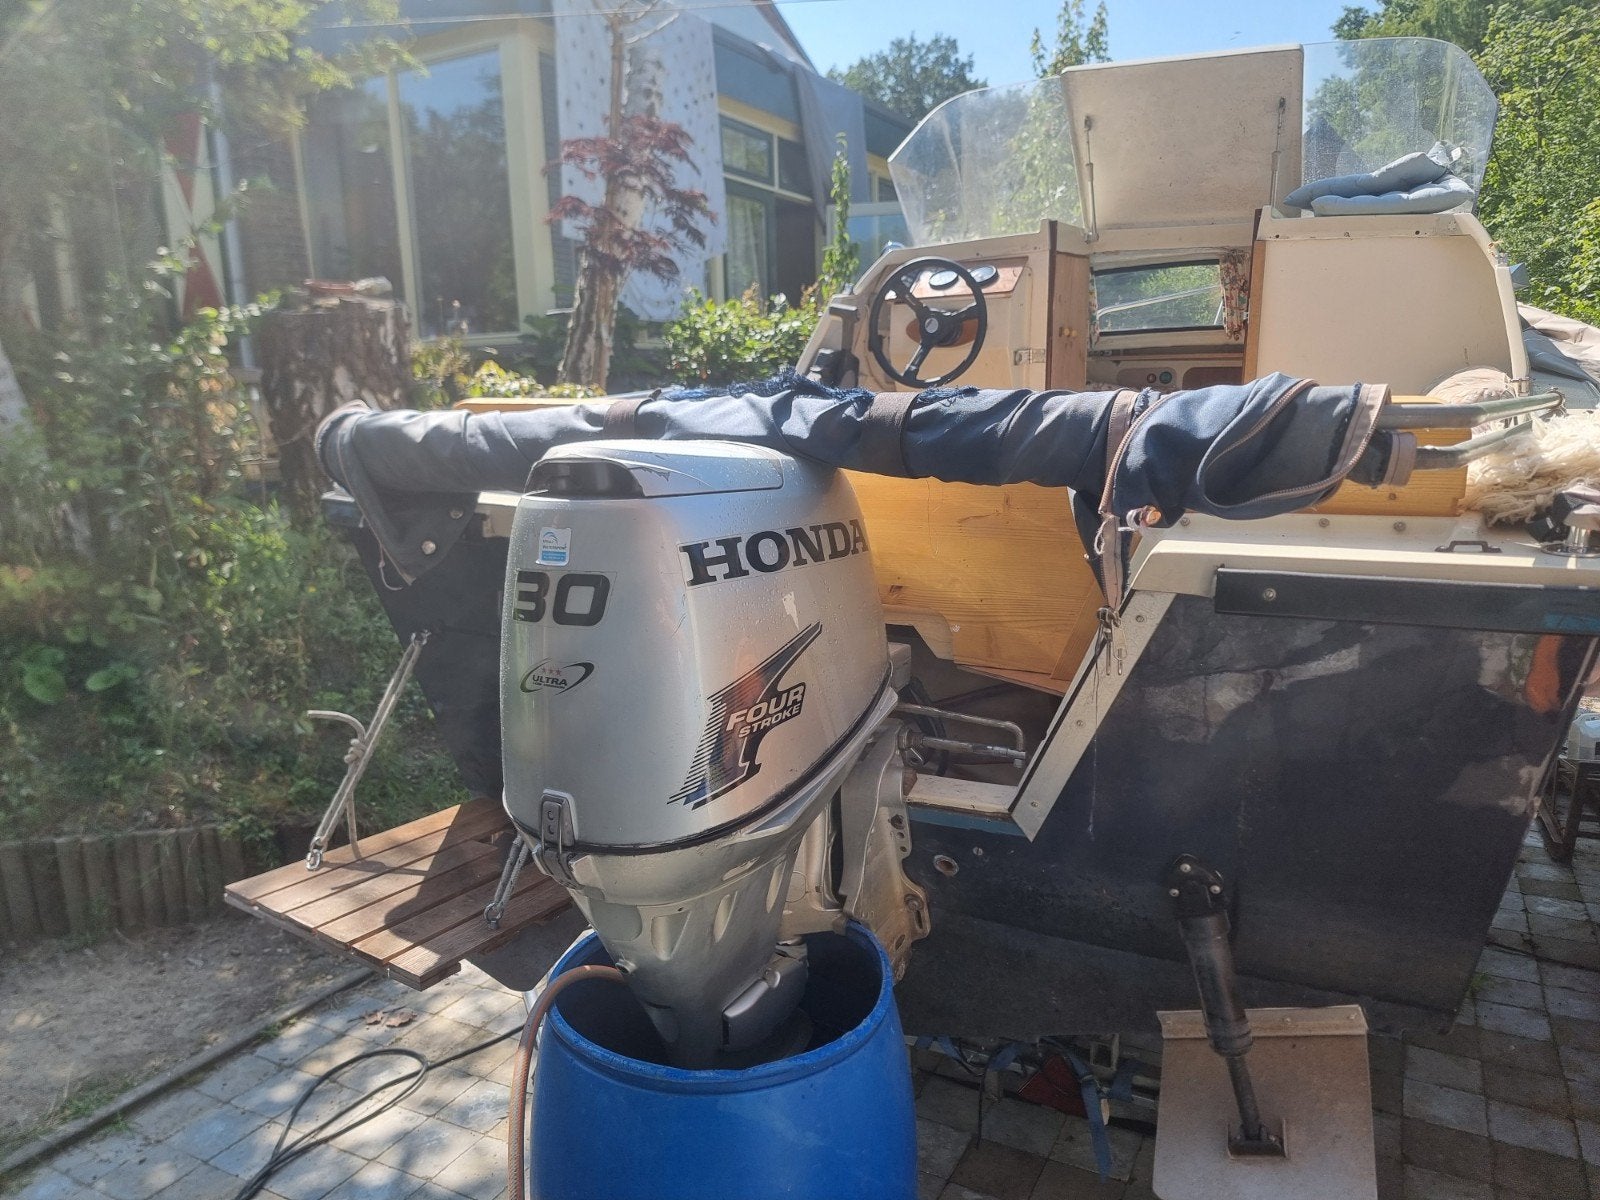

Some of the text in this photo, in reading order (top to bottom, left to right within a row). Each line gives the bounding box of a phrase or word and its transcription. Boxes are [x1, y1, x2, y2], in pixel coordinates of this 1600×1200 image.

[679, 519, 869, 586] HONDA
[513, 571, 610, 626] 30
[532, 674, 567, 686] ULTRA
[726, 685, 804, 731] FOUR
[738, 703, 801, 738] STROKE
